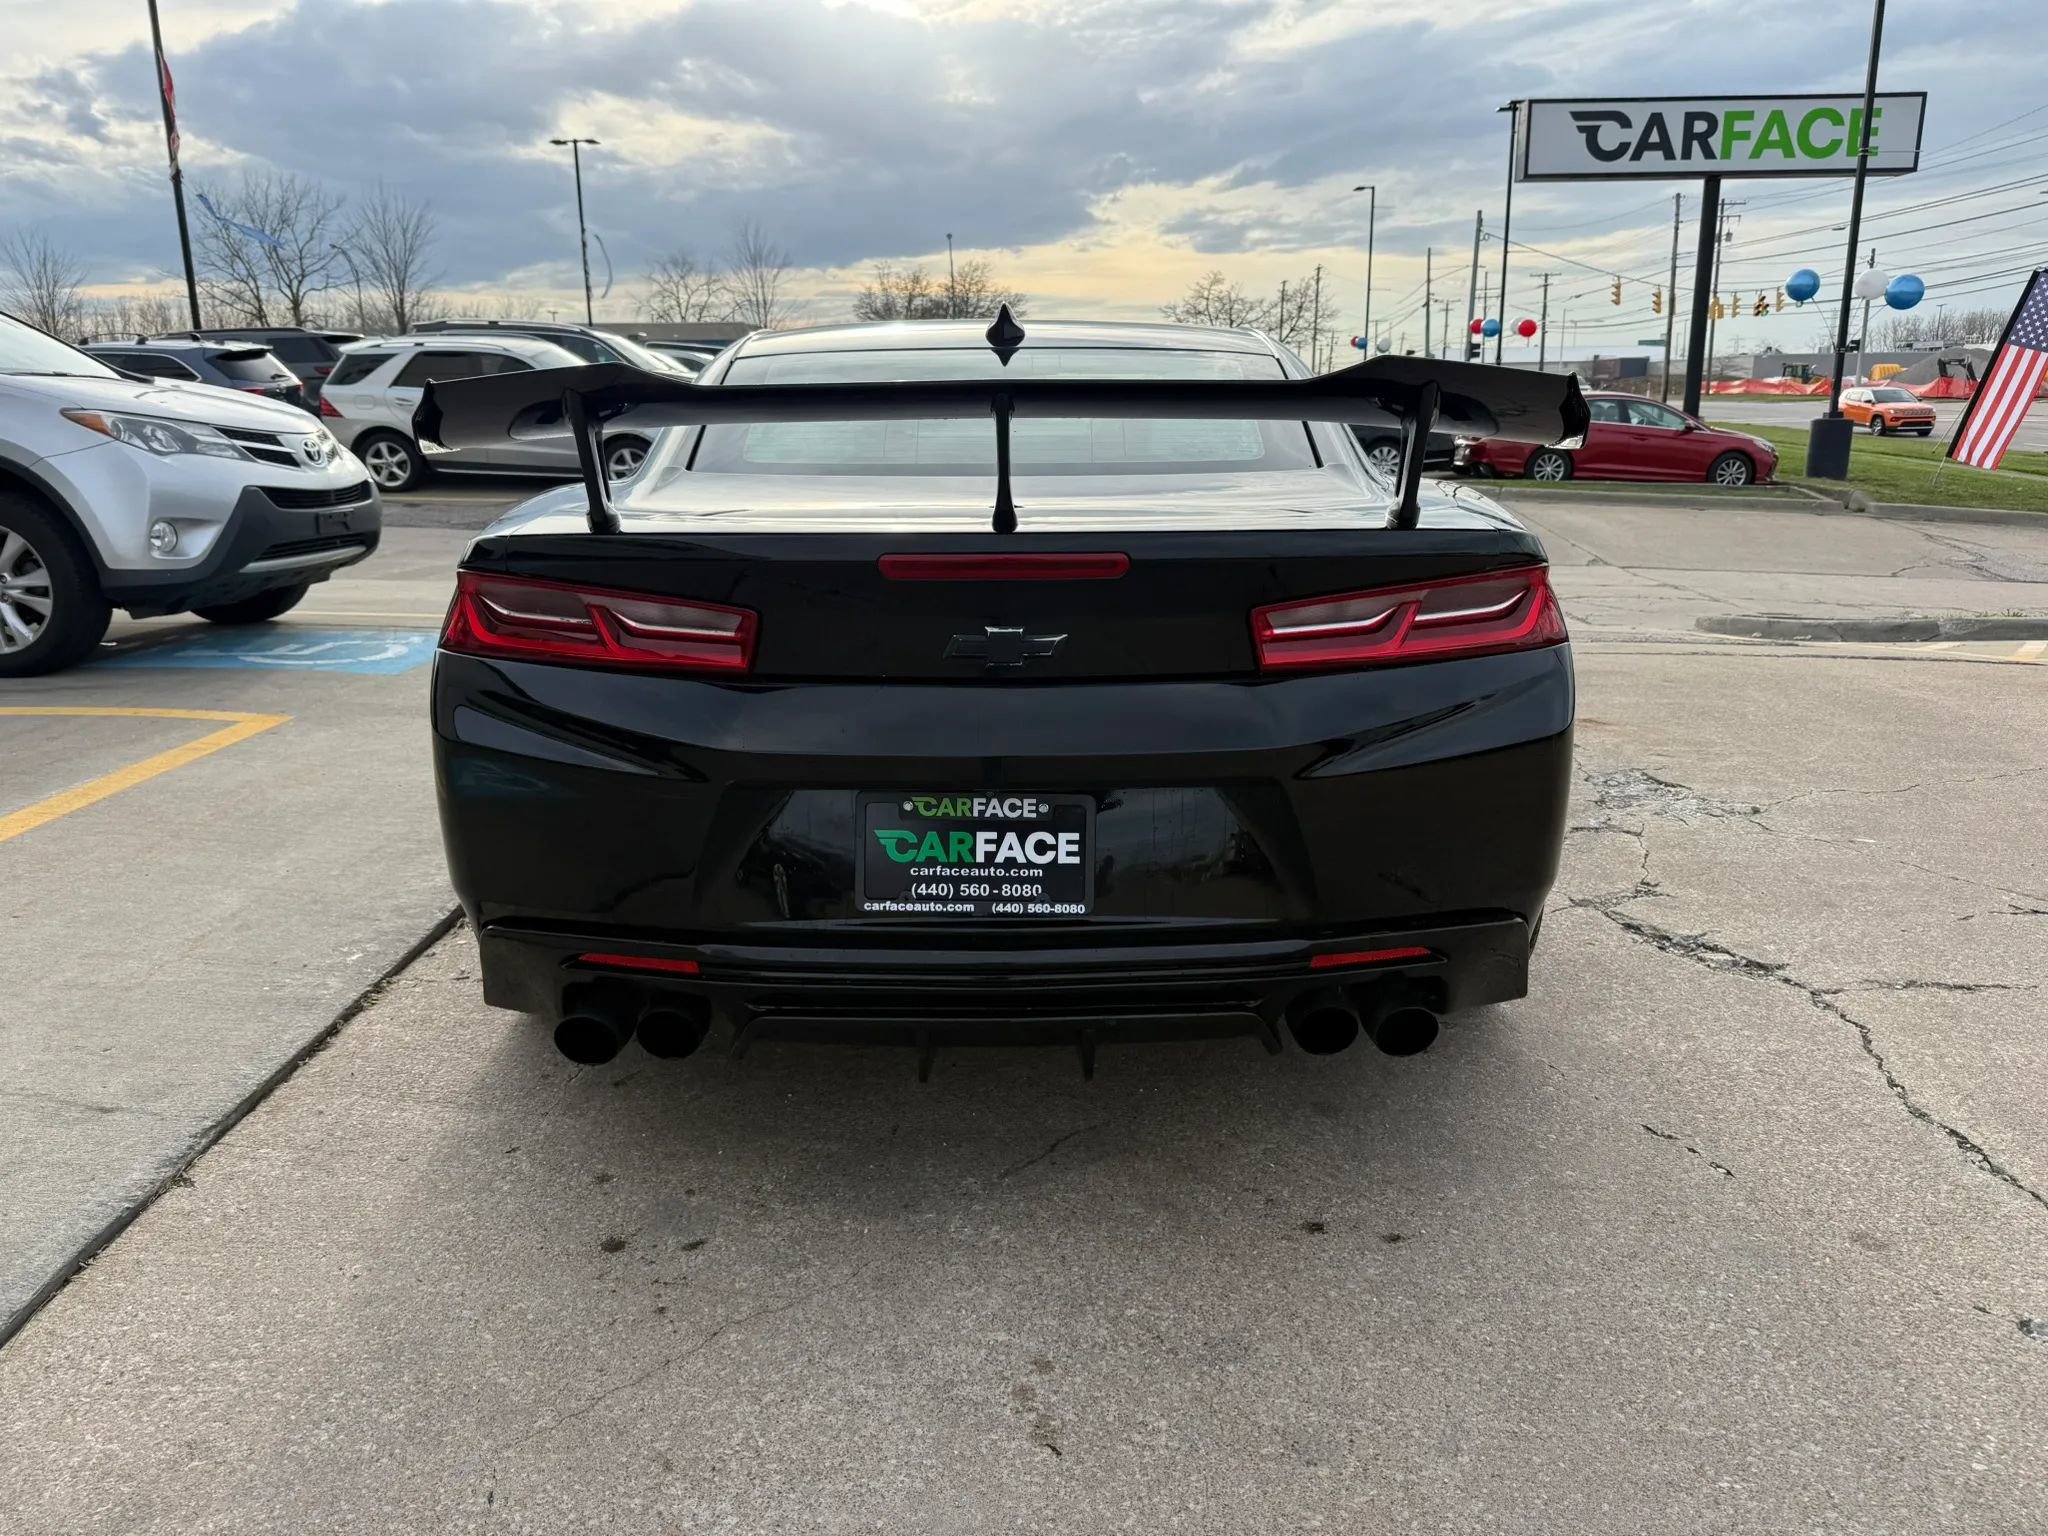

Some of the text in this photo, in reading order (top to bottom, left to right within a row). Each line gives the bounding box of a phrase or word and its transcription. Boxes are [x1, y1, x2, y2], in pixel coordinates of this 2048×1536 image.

[1569, 107, 1882, 162] CARFACE
[912, 797, 1037, 818] CARFACE
[874, 829, 1080, 865] CARFACE
[910, 865, 1043, 877] carfaceauto.com
[911, 883, 954, 899] (440)
[863, 901, 975, 912] carfaceauto.com
[991, 903, 1085, 914] (440) 560-8080
